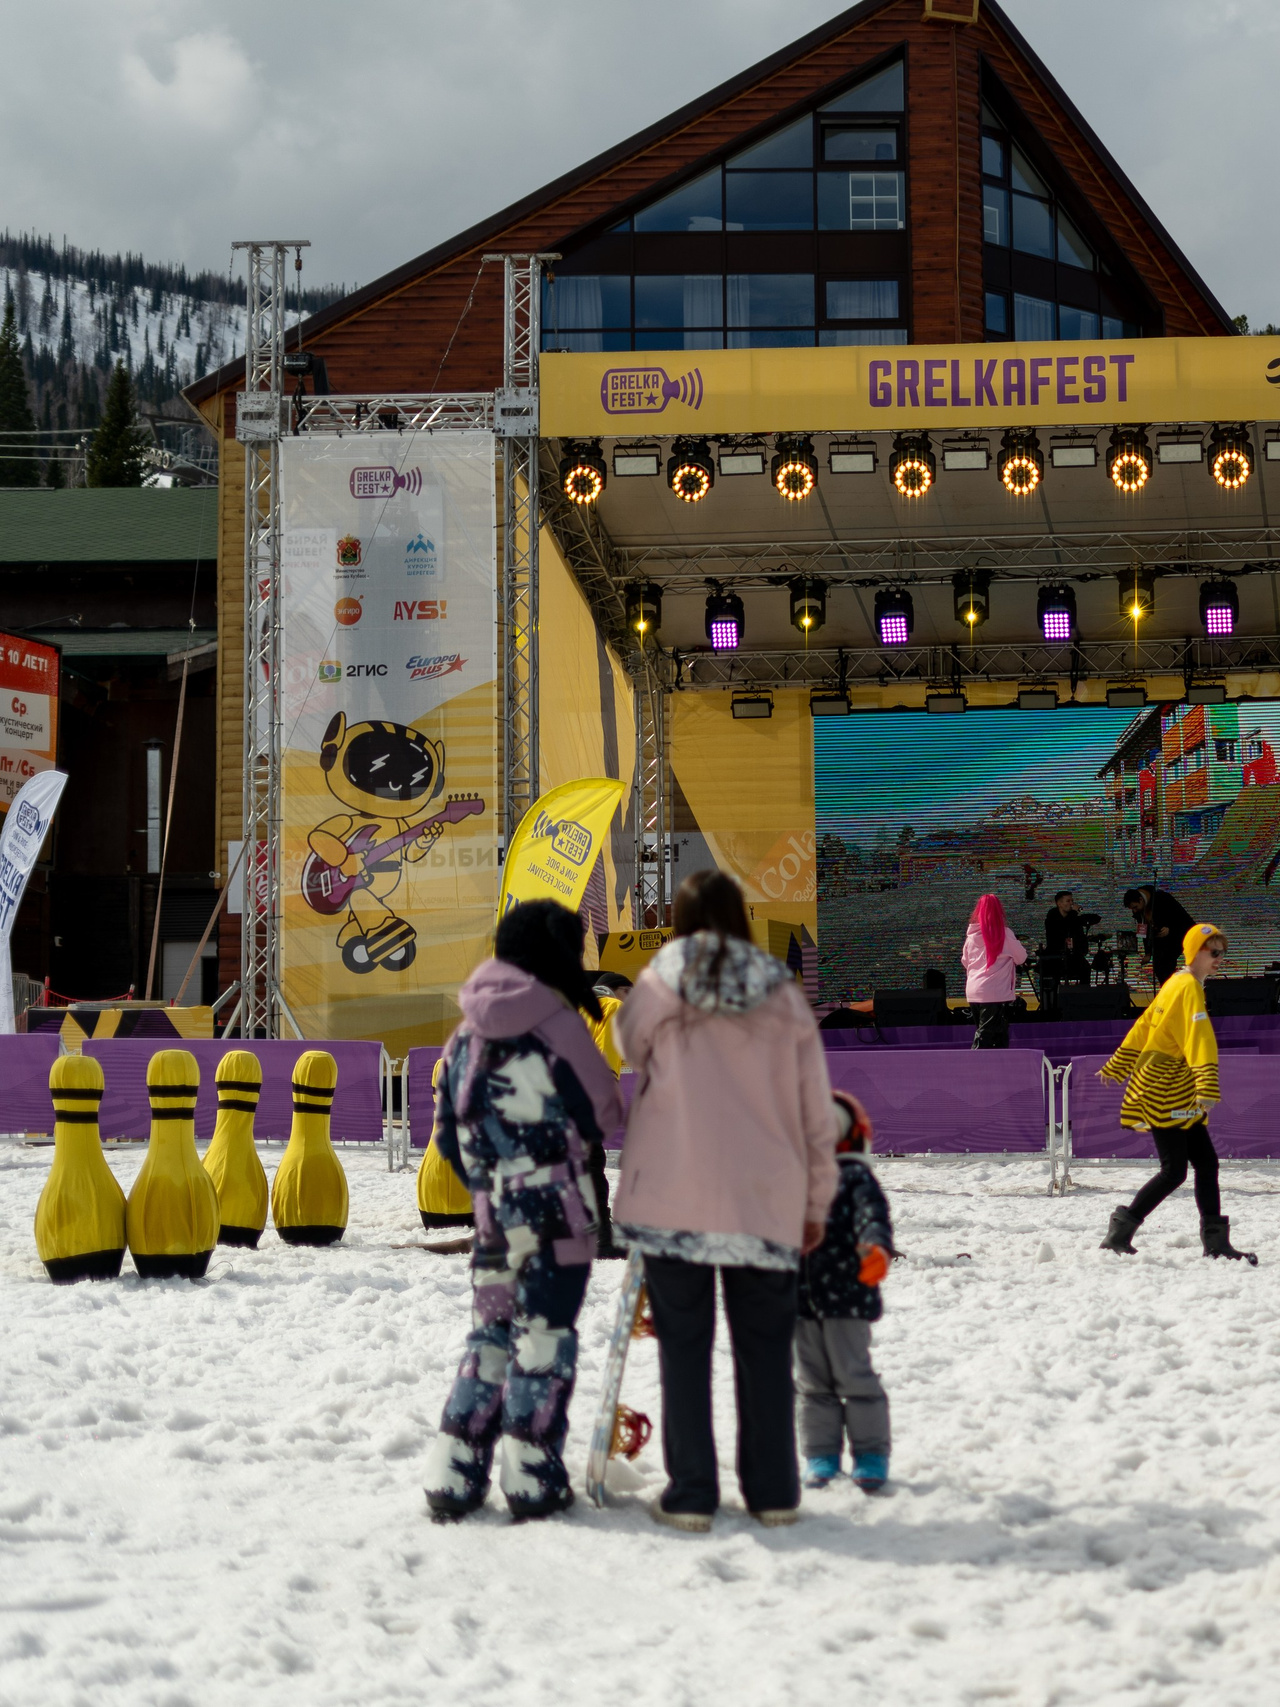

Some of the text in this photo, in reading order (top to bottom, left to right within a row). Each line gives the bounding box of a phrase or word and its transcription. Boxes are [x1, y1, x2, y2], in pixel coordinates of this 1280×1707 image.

[611, 374, 659, 390] GRELKA
[869, 354, 1135, 407] GRELKAFEST
[611, 392, 644, 407] FEST
[356, 471, 391, 482] GRELKA
[357, 484, 379, 494] FEST
[393, 600, 447, 620] AYS!
[7, 649, 19, 665] 10
[22, 653, 49, 672] ЛЕТ!
[346, 664, 388, 677] 2ГИС
[0, 716, 43, 733] кустический
[5, 727, 33, 740] концерт
[413, 847, 507, 868] ВЫБИ
